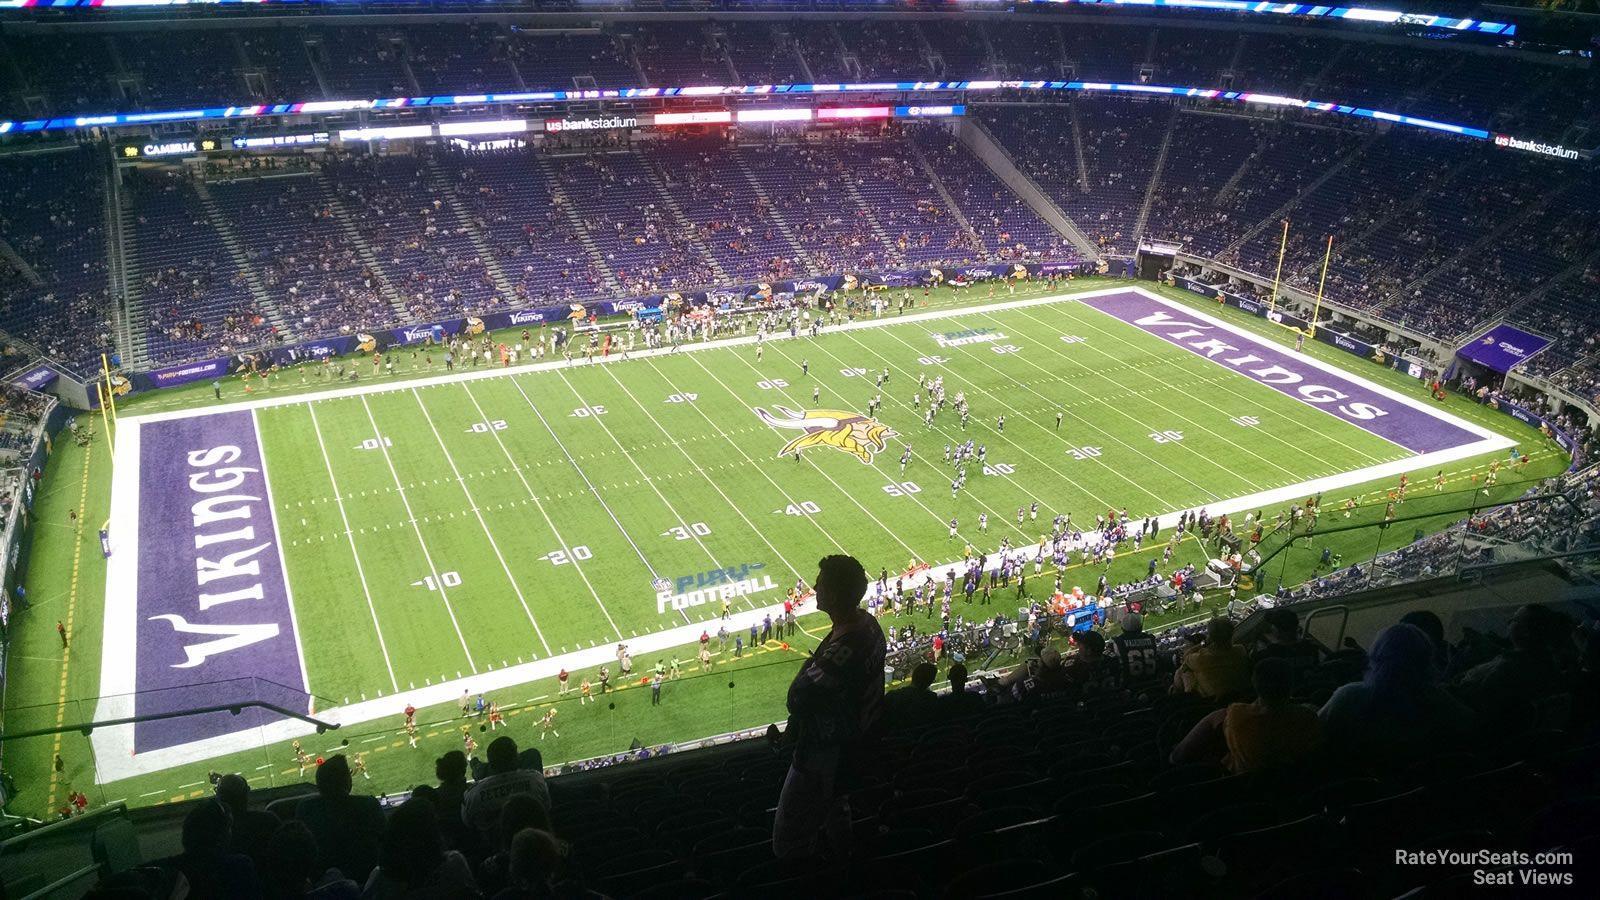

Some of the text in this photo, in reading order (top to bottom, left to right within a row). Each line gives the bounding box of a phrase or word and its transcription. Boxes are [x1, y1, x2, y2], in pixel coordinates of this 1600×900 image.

[143, 142, 196, 155] CAMBRIA
[509, 311, 544, 325] VIKINGS
[1135, 311, 1389, 420] VIKINGS
[756, 378, 789, 389] 50
[668, 392, 698, 403] 40
[573, 405, 608, 417] 30
[471, 419, 508, 433] 20
[1230, 415, 1260, 427] 10
[1147, 430, 1184, 444] 20
[1065, 446, 1101, 460] 30
[982, 463, 1015, 477] 40
[881, 481, 922, 497] 50
[783, 500, 822, 517] 40
[668, 521, 712, 541] 30
[148, 445, 280, 668] VIKINGS
[547, 545, 593, 565] 20
[423, 571, 463, 591] 10
[656, 575, 779, 614] FOOTBALL
